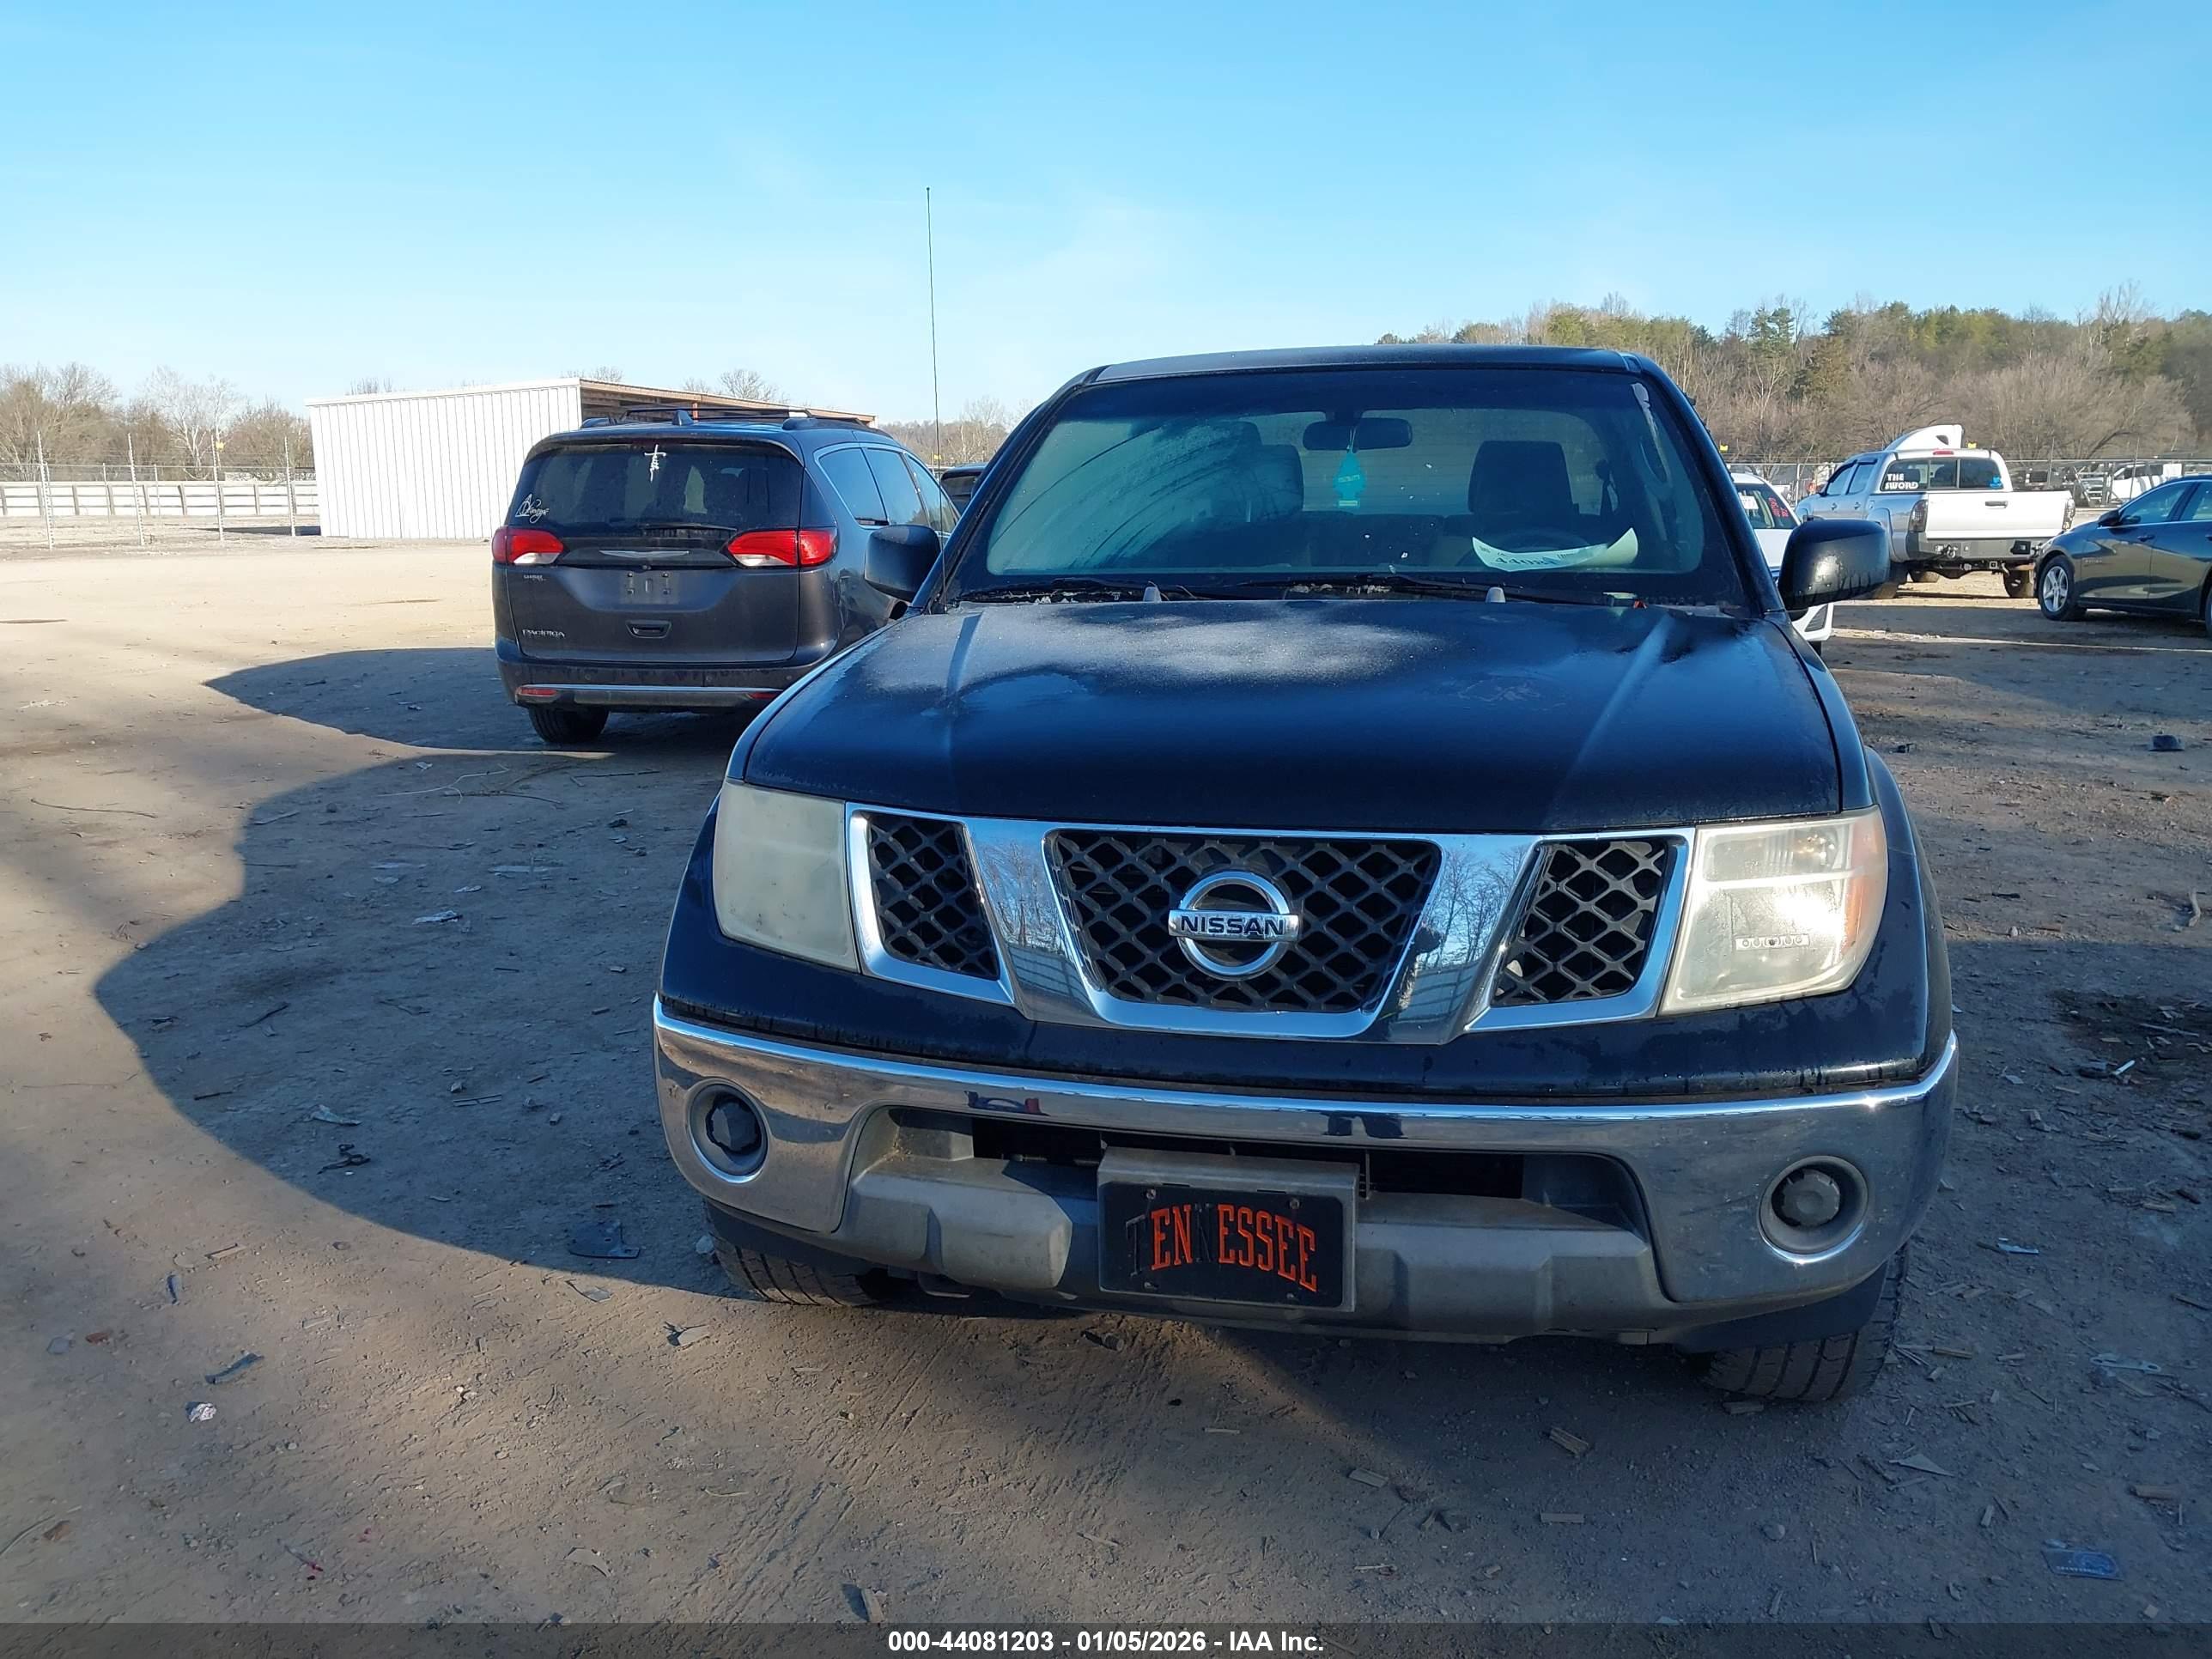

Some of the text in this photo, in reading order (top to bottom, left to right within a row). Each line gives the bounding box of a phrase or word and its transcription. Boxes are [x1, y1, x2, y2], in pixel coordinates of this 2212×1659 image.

[1887, 473, 1905, 482] THE
[1885, 481, 1919, 489] SWORD
[1181, 915, 1284, 936] NISSAN
